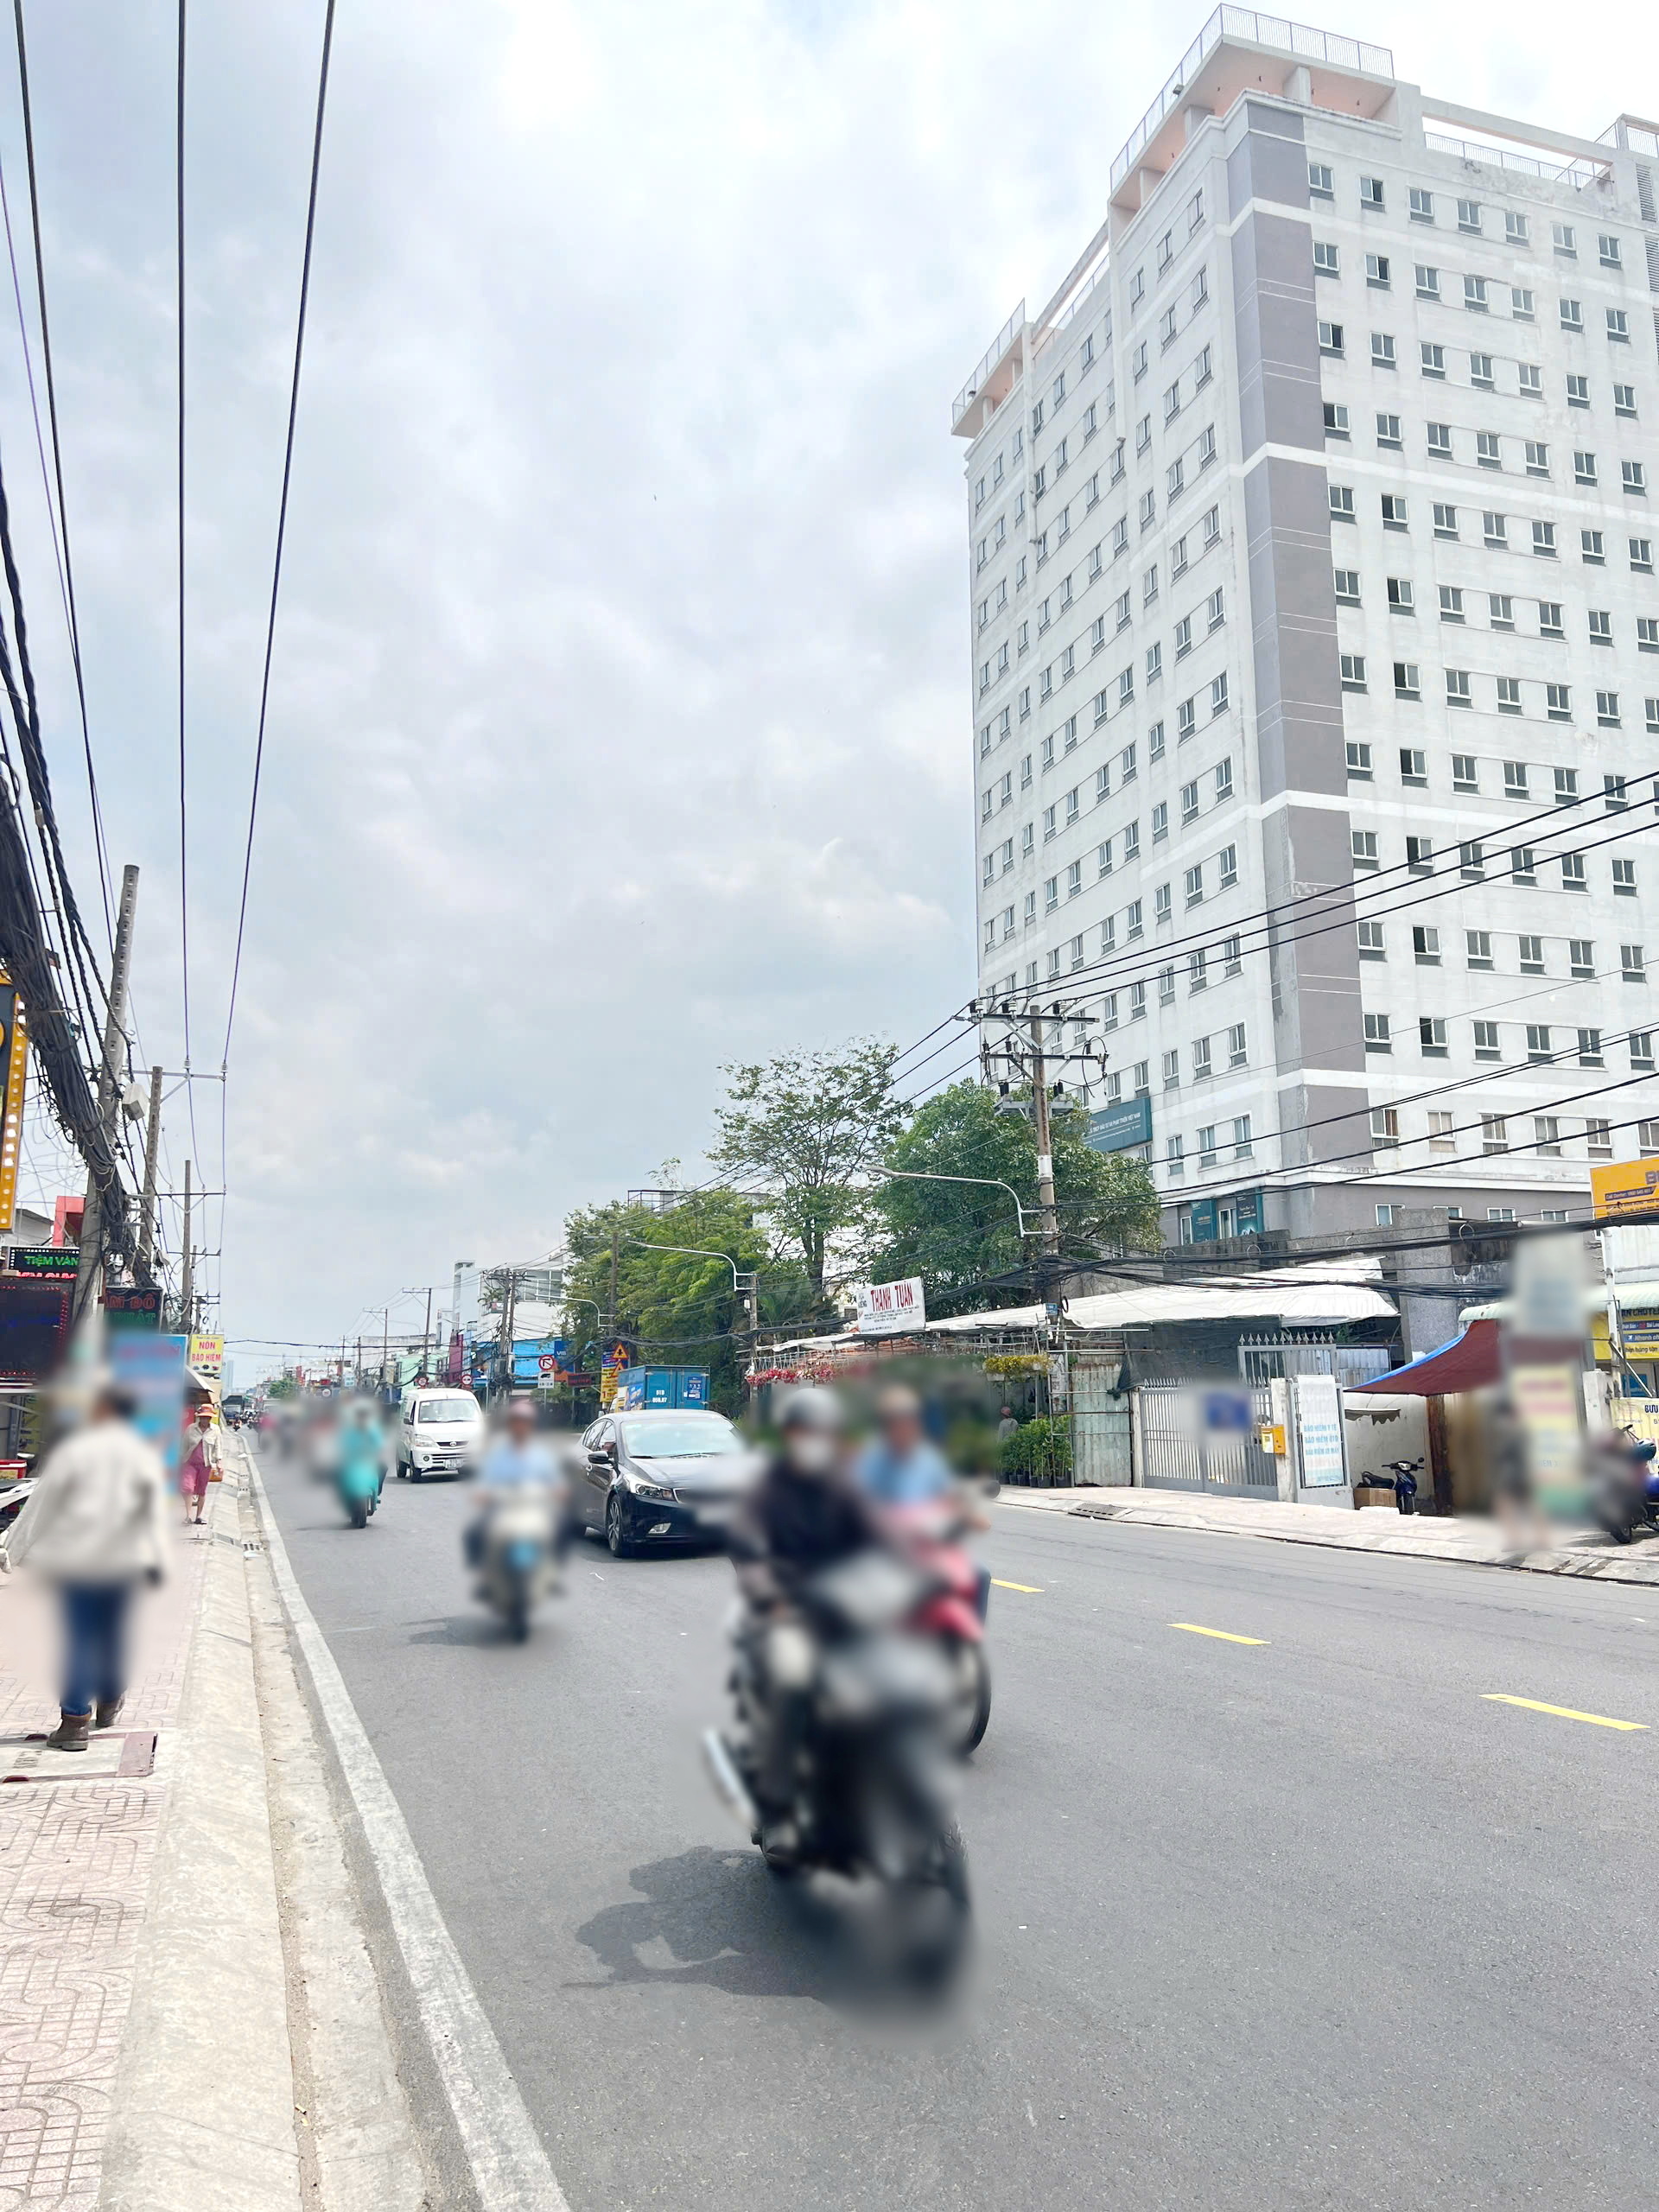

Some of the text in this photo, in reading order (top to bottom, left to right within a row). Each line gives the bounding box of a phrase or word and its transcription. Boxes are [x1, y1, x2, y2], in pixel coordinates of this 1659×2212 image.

[24, 1254, 79, 1268] TIỆM VÀN
[870, 1287, 893, 1313] THANH
